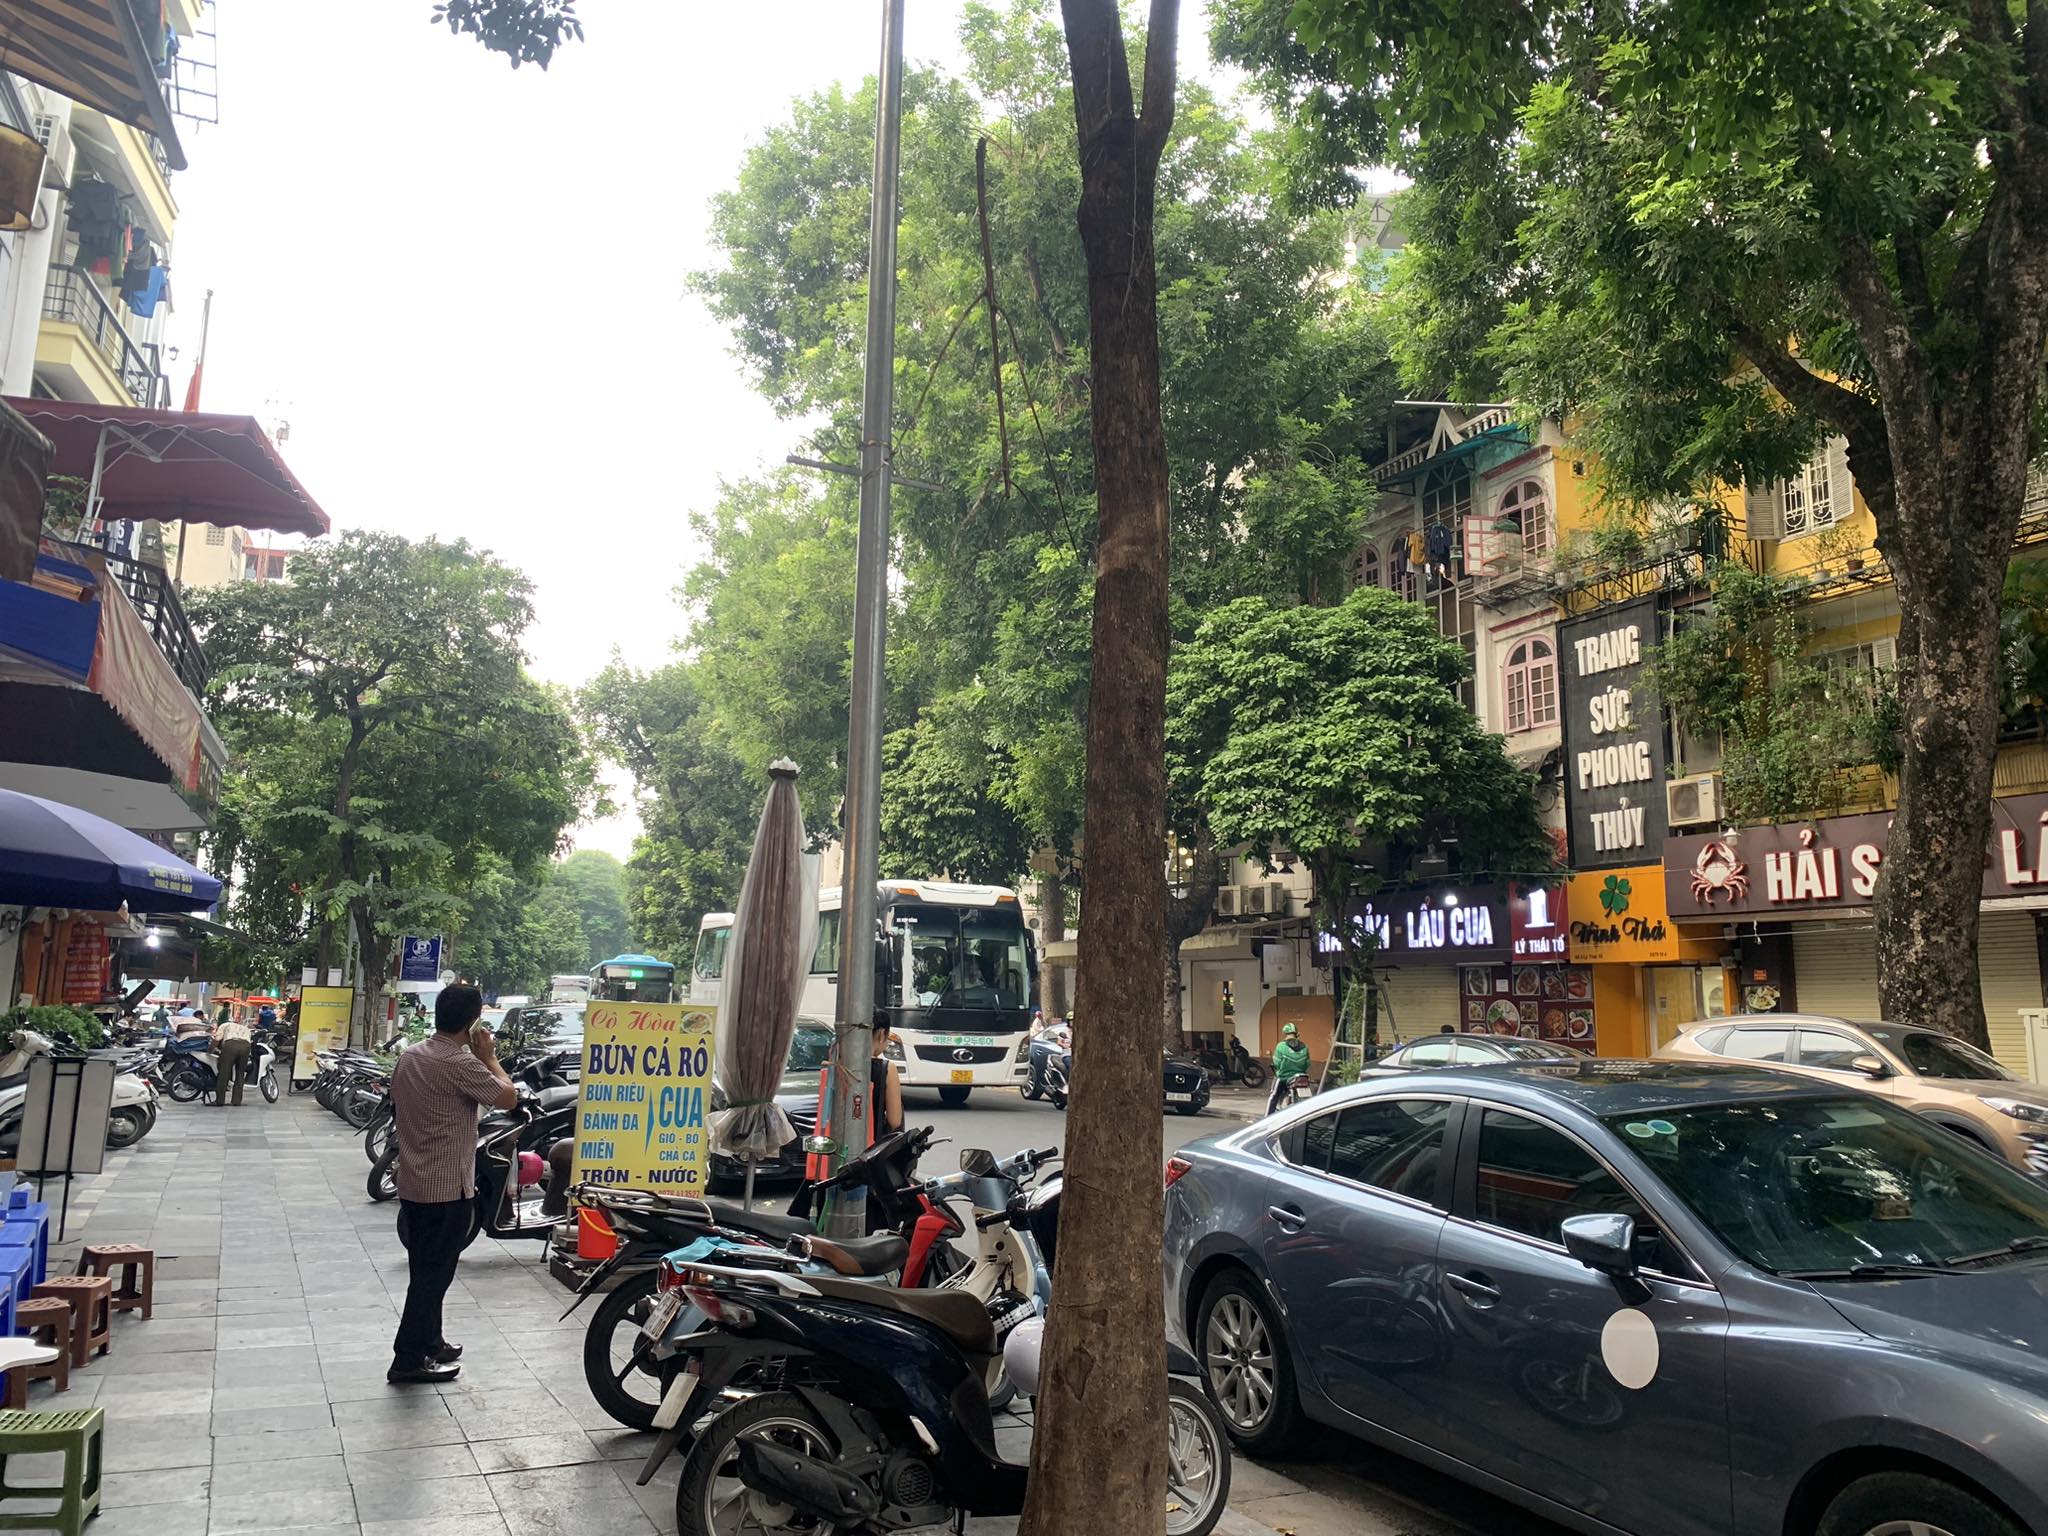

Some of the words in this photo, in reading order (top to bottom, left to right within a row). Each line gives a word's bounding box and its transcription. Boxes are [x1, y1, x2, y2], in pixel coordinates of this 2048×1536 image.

[1574, 625, 1641, 677] TRANG
[1577, 741, 1652, 790] PHONG
[1590, 796, 1646, 852] THỦY
[1764, 828, 1839, 901] HẢI
[1450, 905, 1494, 947] CUA
[1524, 888, 1555, 928] 1
[1514, 937, 1526, 954] LÝ
[1529, 936, 1550, 953] THÁI
[591, 1009, 618, 1030] Cô
[628, 1010, 676, 1032] Hòa
[588, 1035, 638, 1075] BÚN
[642, 1037, 673, 1076] CÁ
[678, 1038, 709, 1077] RÔ
[586, 1081, 613, 1101] BÚN
[616, 1082, 645, 1102] RIÊU
[659, 1085, 703, 1128] CUA
[583, 1109, 619, 1130] BÁNH
[622, 1113, 639, 1131] ĐA
[581, 1166, 629, 1186] TRỘN
[648, 1164, 698, 1184] NƯỚC
